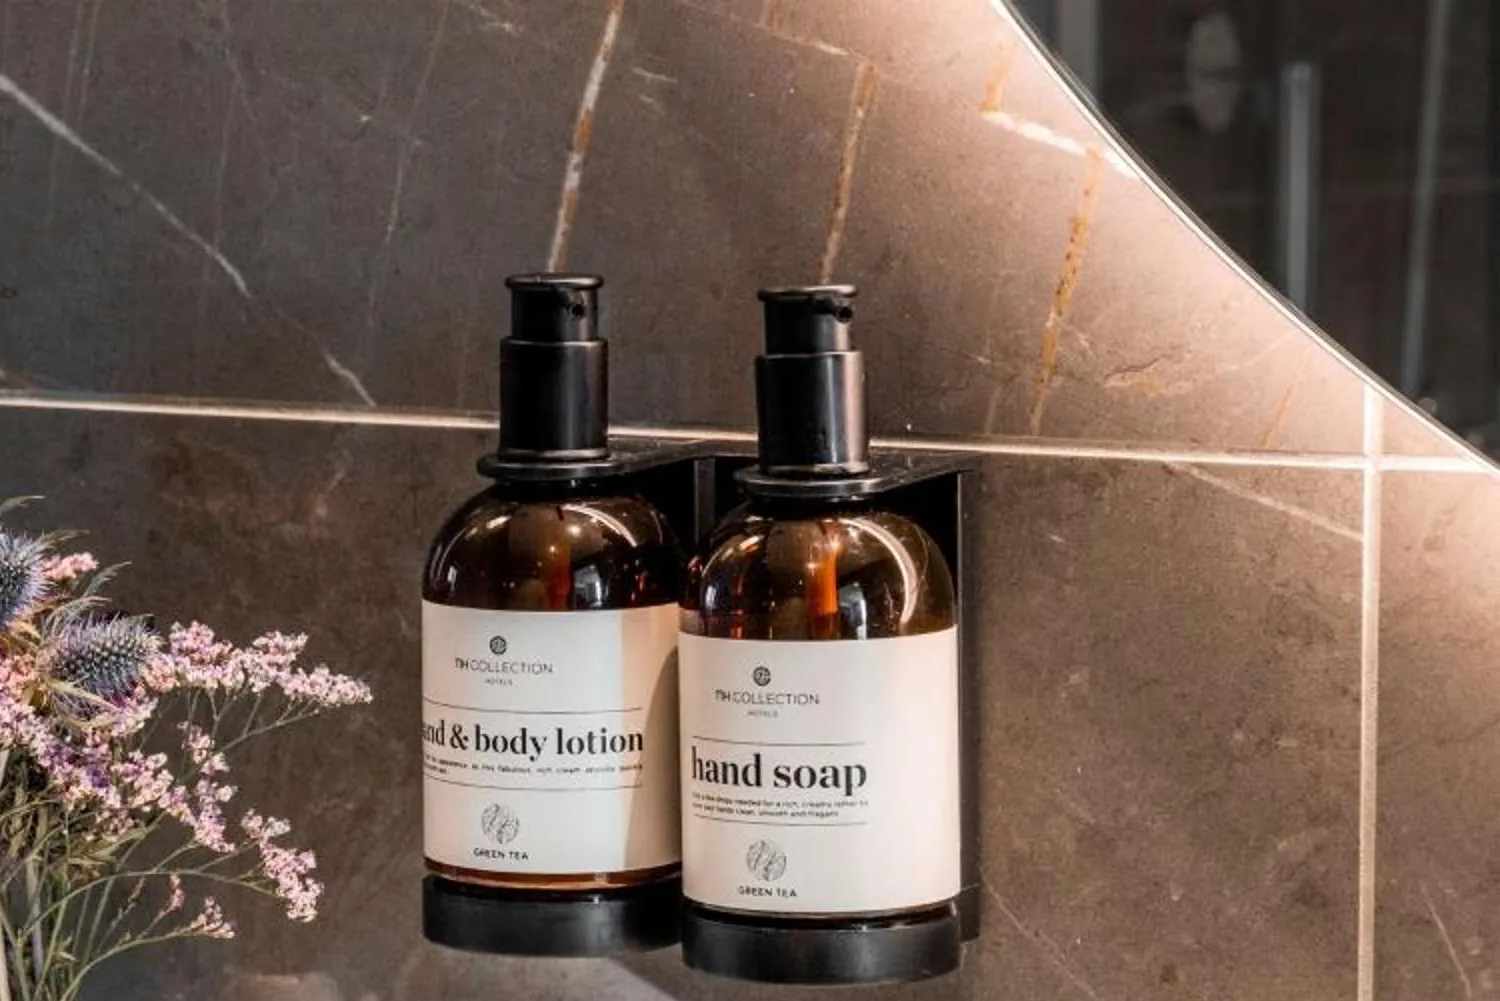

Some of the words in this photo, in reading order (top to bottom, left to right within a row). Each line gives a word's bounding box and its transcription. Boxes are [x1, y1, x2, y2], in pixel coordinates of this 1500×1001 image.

[469, 658, 553, 675] COLLECTION
[732, 691, 820, 705] COLLECTION
[449, 722, 469, 750] &
[474, 723, 547, 763] body
[556, 727, 644, 755] lotion
[691, 744, 763, 788] hand
[772, 763, 868, 797] soap
[473, 847, 505, 860] GREEN
[508, 850, 530, 861] TEA
[737, 885, 773, 897] GREEN
[776, 887, 799, 898] TEA
